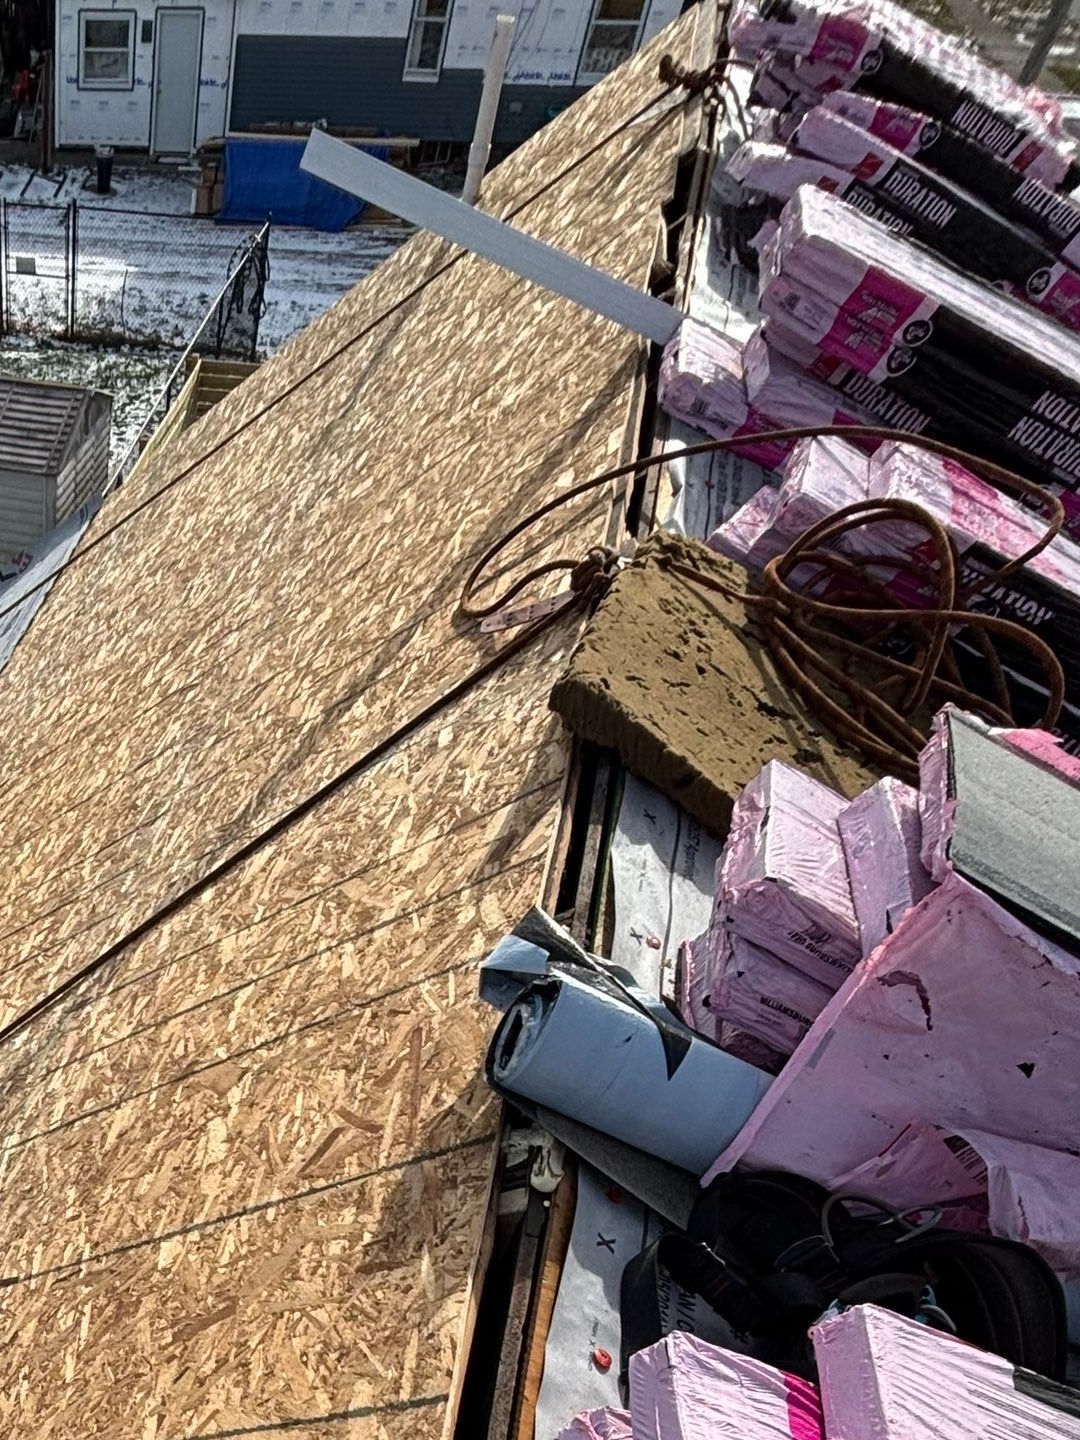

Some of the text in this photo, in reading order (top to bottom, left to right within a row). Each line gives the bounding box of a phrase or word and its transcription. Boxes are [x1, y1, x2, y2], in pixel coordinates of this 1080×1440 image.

[950, 100, 1020, 158] DURATION
[884, 170, 957, 229] DURATION
[845, 372, 932, 434] DURATION
[1007, 416, 1080, 473] URATION
